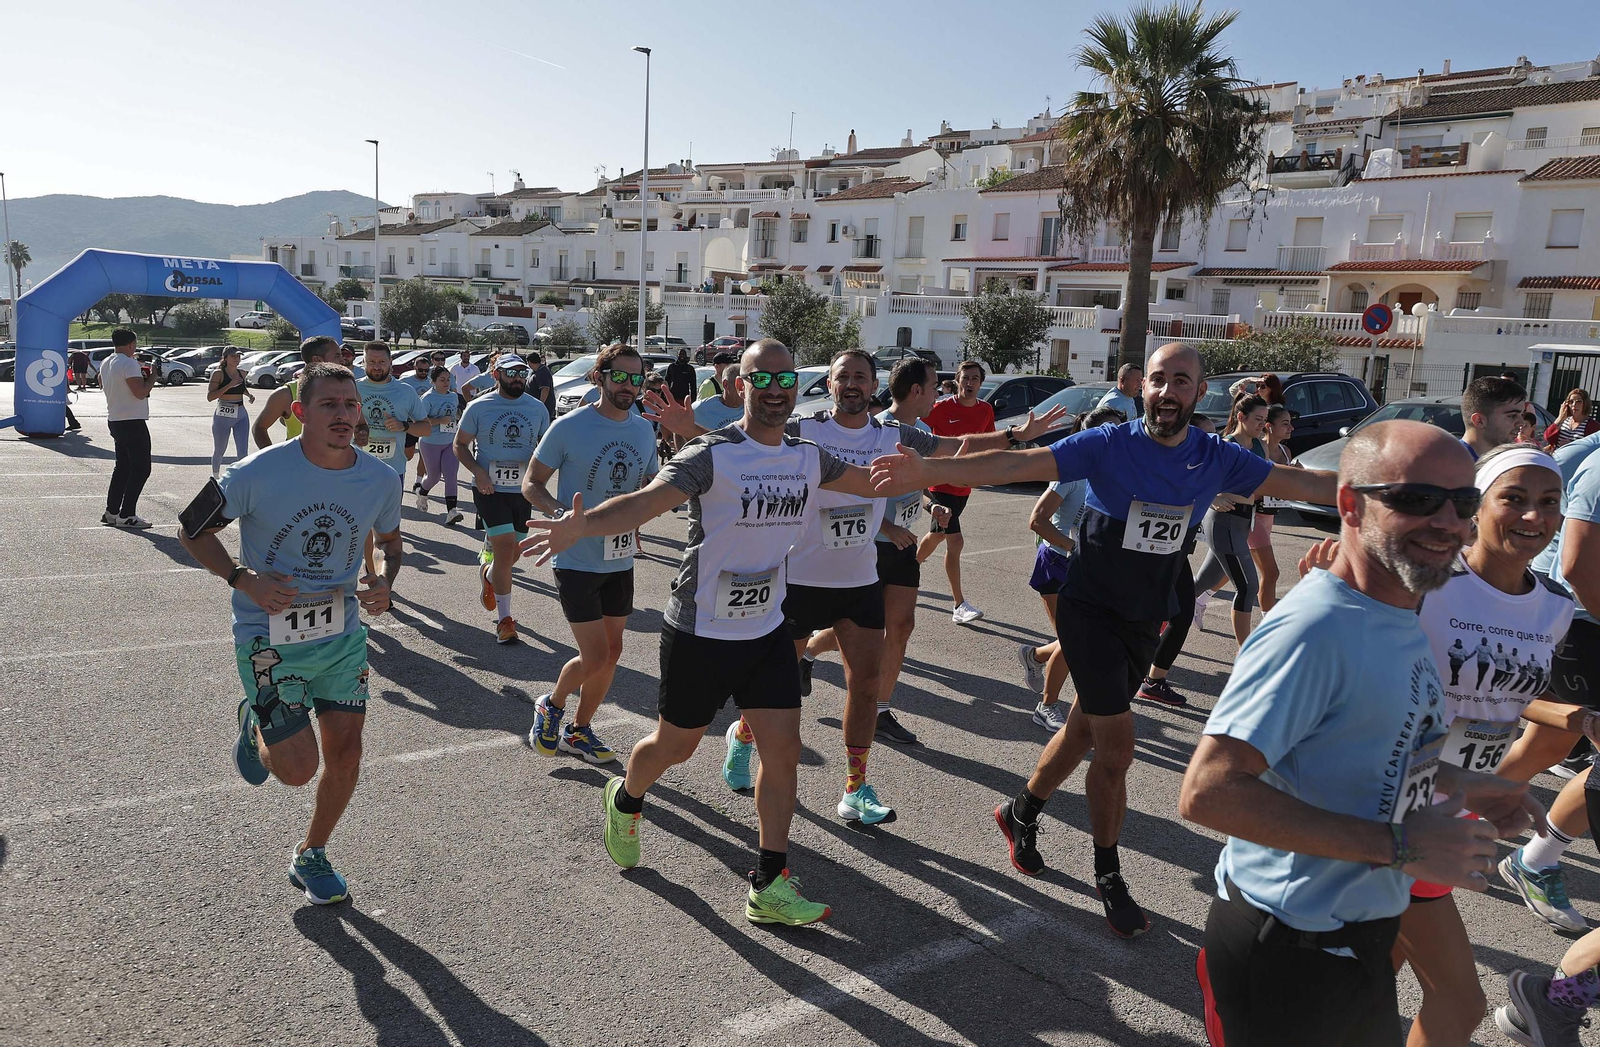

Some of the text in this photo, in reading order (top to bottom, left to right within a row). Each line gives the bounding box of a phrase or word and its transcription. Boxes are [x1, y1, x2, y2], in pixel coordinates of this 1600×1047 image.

[163, 258, 220, 270] META
[220, 406, 235, 414] 209
[369, 444, 391, 454] 281
[600, 441, 620, 456] URBANA
[621, 441, 639, 457] CIUDAD
[495, 469, 520, 479] 115
[740, 473, 761, 482] Corre,
[778, 474, 789, 482] que
[291, 502, 326, 523] URBANA
[329, 502, 355, 525] CIUDAD
[901, 503, 920, 521] 187
[270, 523, 294, 550] CARRERA
[350, 524, 359, 535] DE
[831, 519, 866, 537] 176
[1138, 520, 1181, 541] 120
[265, 550, 277, 567] XXIV
[293, 566, 334, 574] Ayuntamiento
[310, 599, 334, 608] ALGECIRAS
[728, 586, 770, 606] 220
[285, 606, 332, 630] 111
[1449, 618, 1486, 634] Corre,
[1488, 625, 1514, 638] corre
[1516, 631, 1534, 642] que
[1535, 632, 1544, 643] te
[1385, 711, 1416, 777] CARRERA
[1464, 731, 1487, 740] CIUDAD
[1459, 743, 1506, 769] 156
[1377, 782, 1396, 816] XXIV
